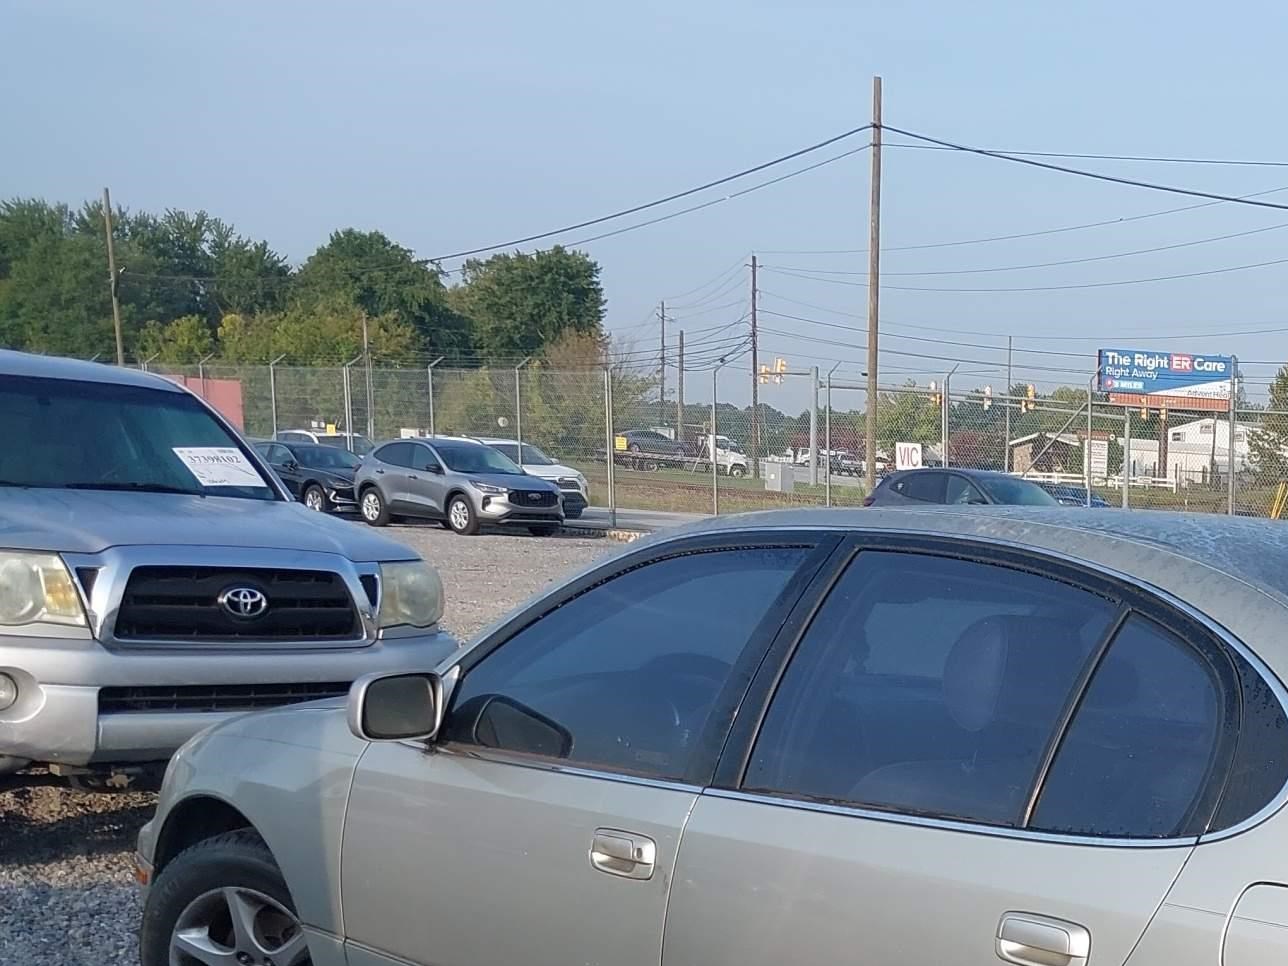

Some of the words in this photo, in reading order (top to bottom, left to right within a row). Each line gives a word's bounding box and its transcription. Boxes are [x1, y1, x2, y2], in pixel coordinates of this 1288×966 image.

[1105, 351, 1131, 366] The
[1134, 353, 1169, 371] Right
[1172, 356, 1191, 370] ER
[1193, 357, 1226, 372] Care
[1105, 366, 1130, 379] Right
[1131, 367, 1159, 381] Away
[899, 446, 919, 467] VIC
